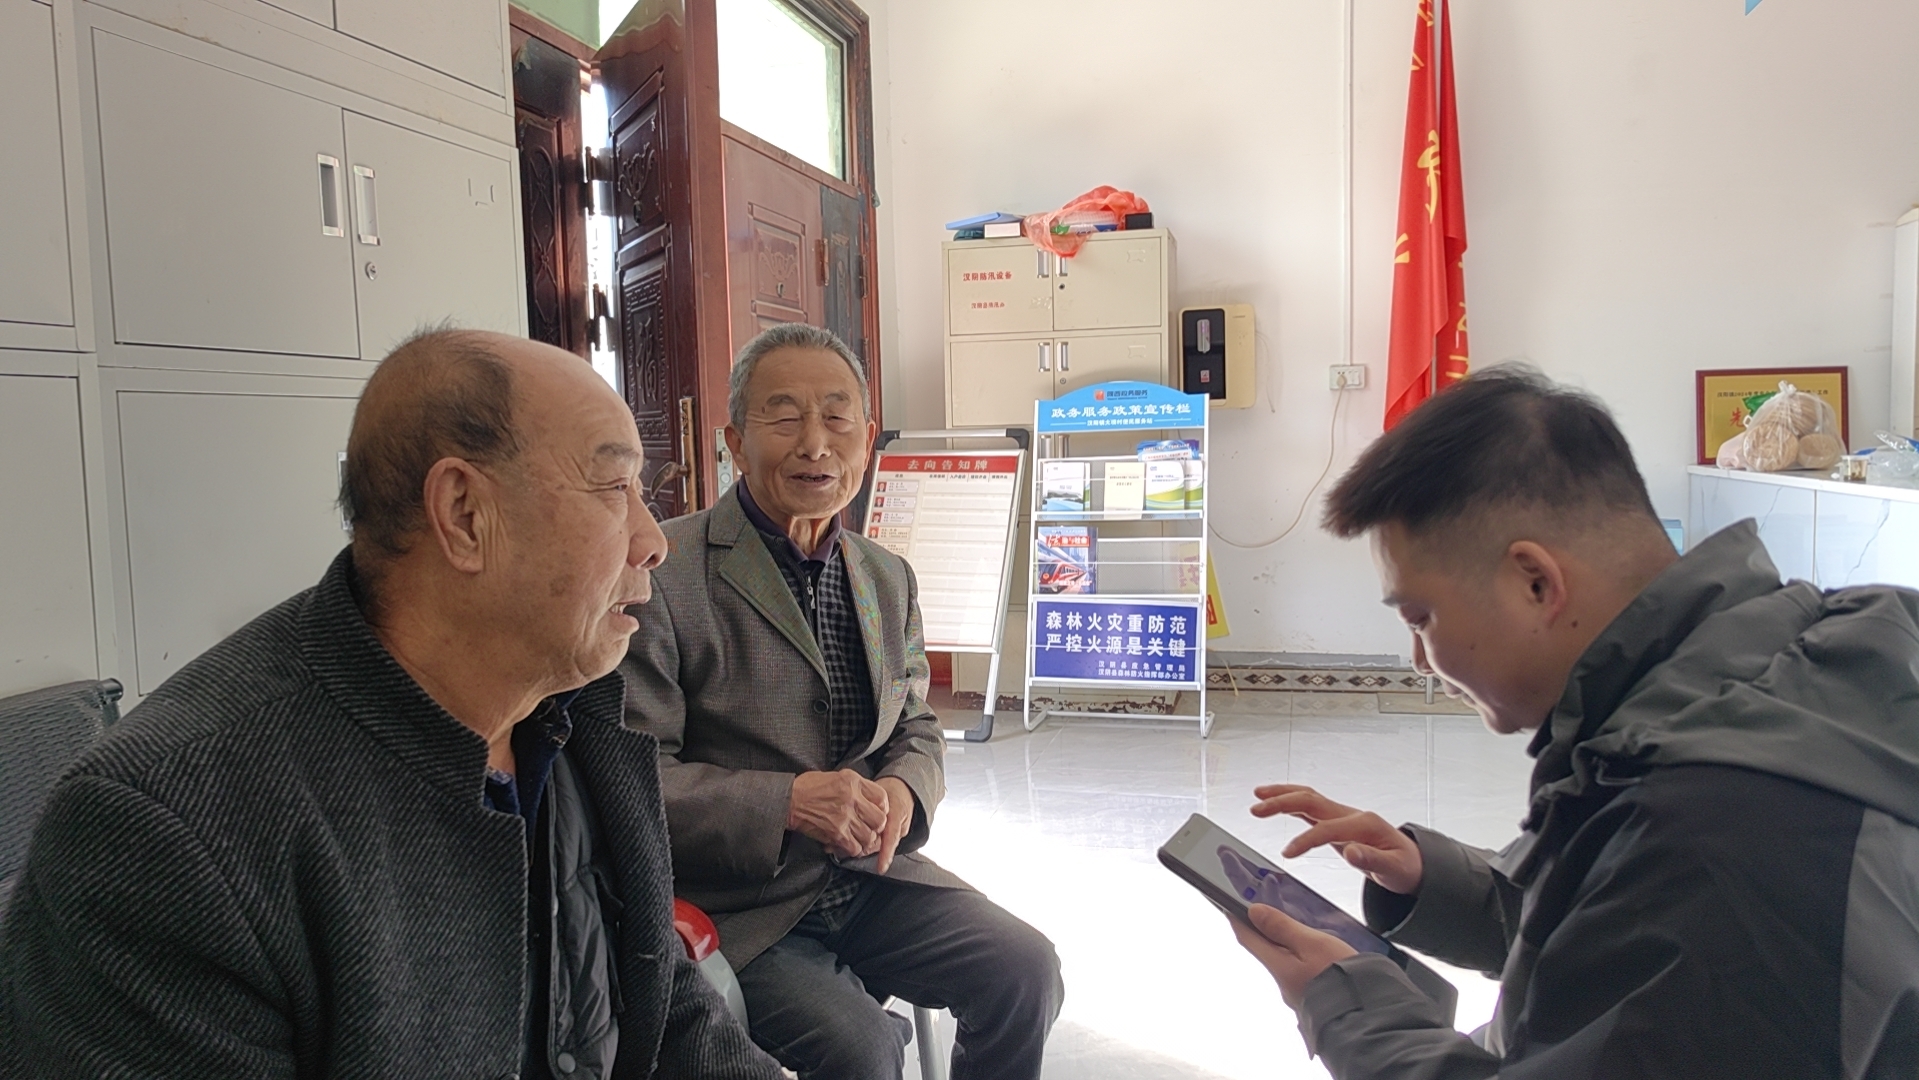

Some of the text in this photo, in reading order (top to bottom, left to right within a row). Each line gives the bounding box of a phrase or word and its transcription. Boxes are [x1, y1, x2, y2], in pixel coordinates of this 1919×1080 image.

[1051, 403, 1191, 419] 政务服务政策宣传栏
[907, 459, 988, 471] 去向告知牌
[1045, 610, 1187, 635] 森林火灾重防范
[1045, 633, 1187, 658] 严控火源是关键
[1098, 660, 1186, 672] 汉阴县应急管理局
[1098, 668, 1186, 681] 汉阴县森林防火指挥部办公室
